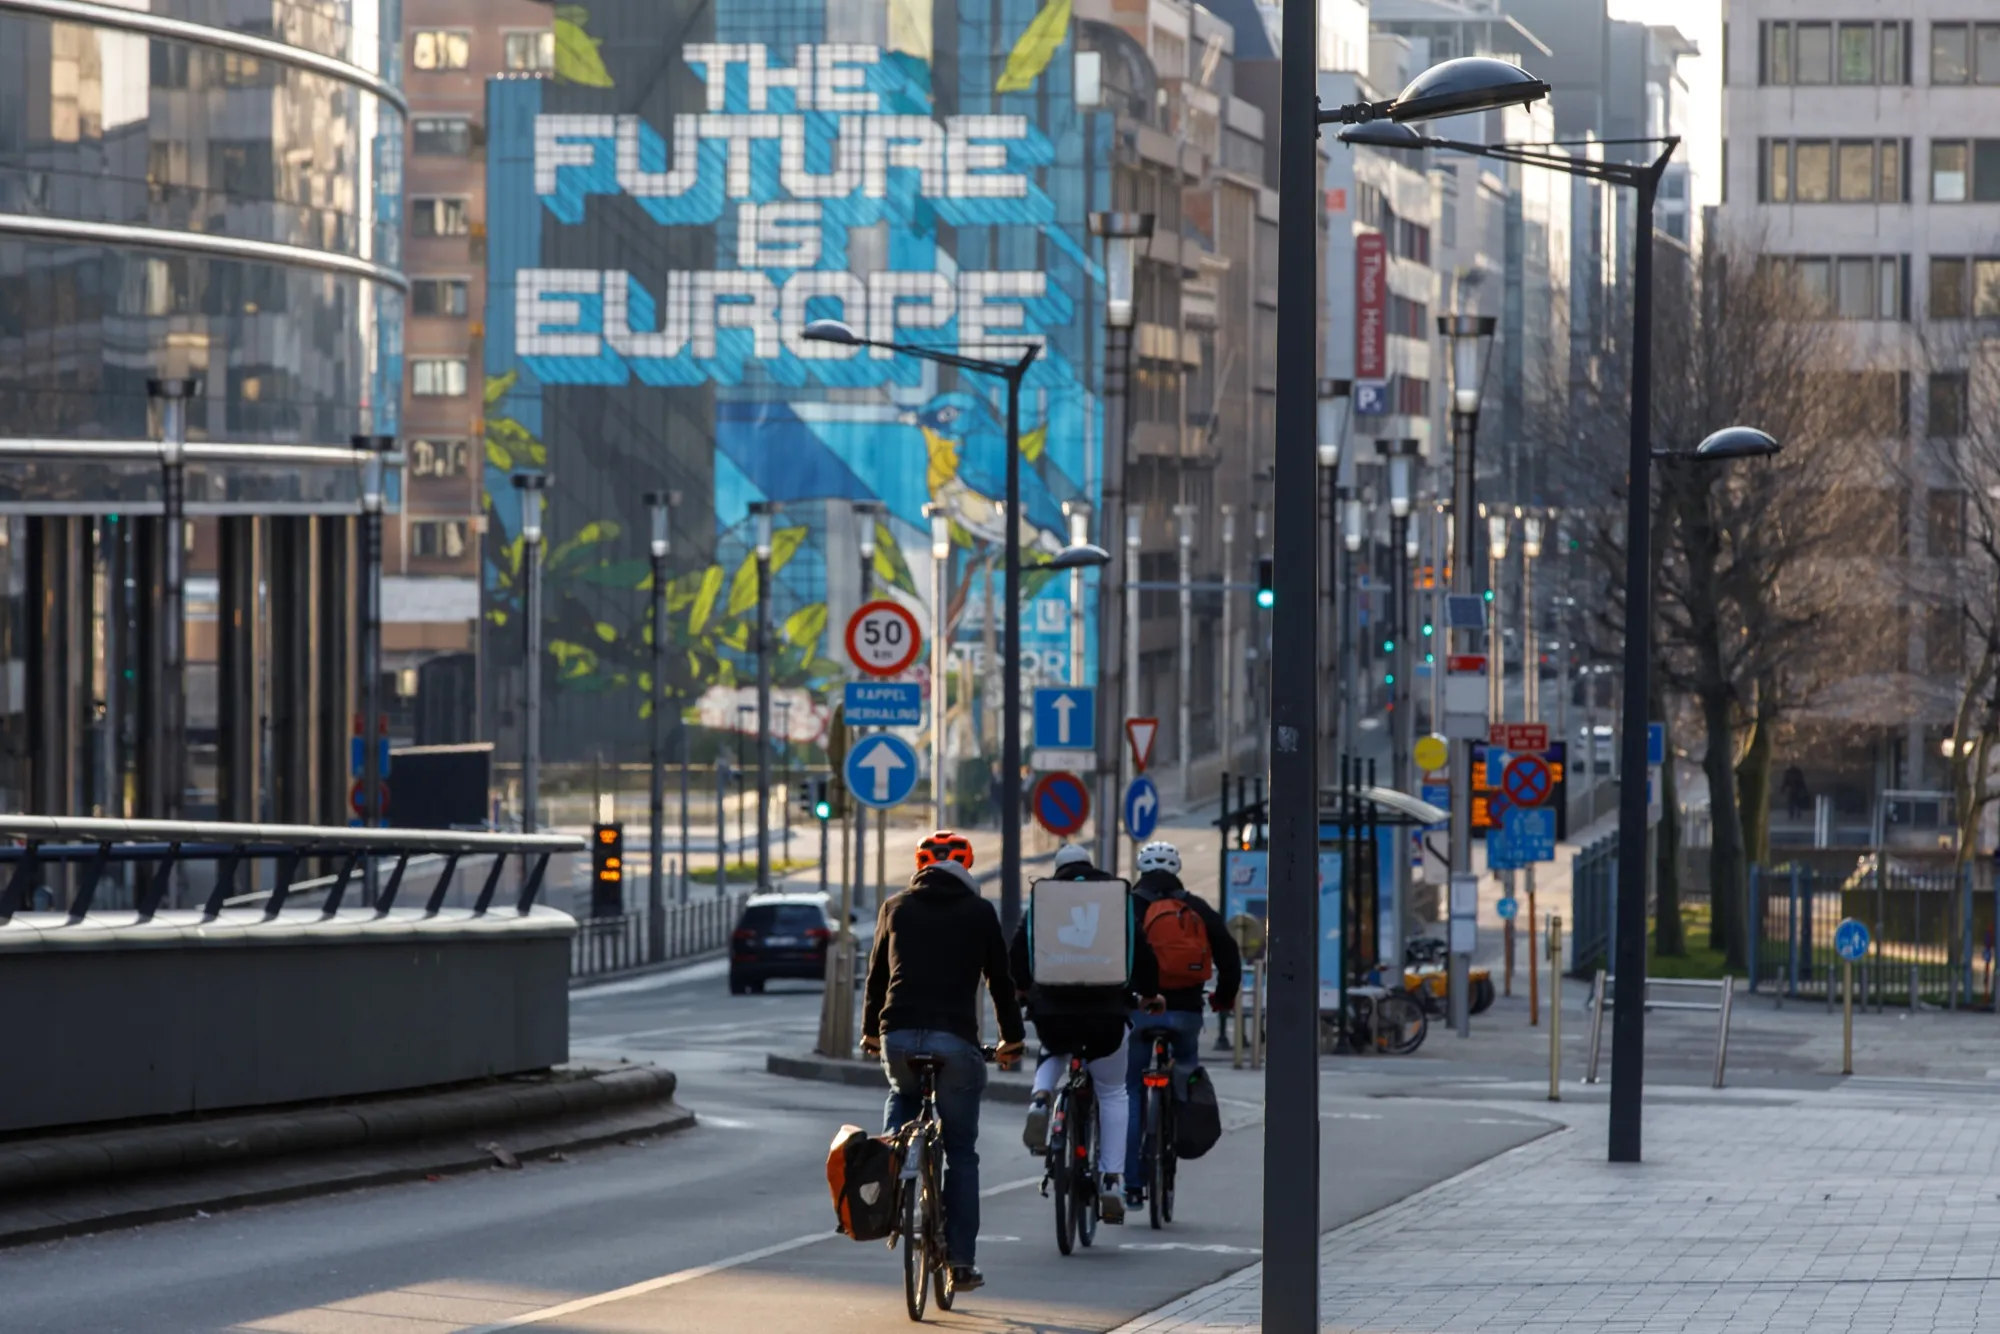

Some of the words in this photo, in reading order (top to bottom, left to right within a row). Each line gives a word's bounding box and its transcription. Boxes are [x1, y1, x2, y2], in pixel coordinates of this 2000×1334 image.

[683, 43, 880, 111] THE
[535, 114, 1027, 199] FUTURE
[737, 201, 822, 268] IS
[1363, 254, 1382, 303] Thon
[516, 268, 1047, 360] EUROPE
[1362, 308, 1380, 371] Hotels
[864, 620, 902, 645] 50
[845, 707, 918, 722] HERHALING
[856, 687, 908, 703] RAPPEL
